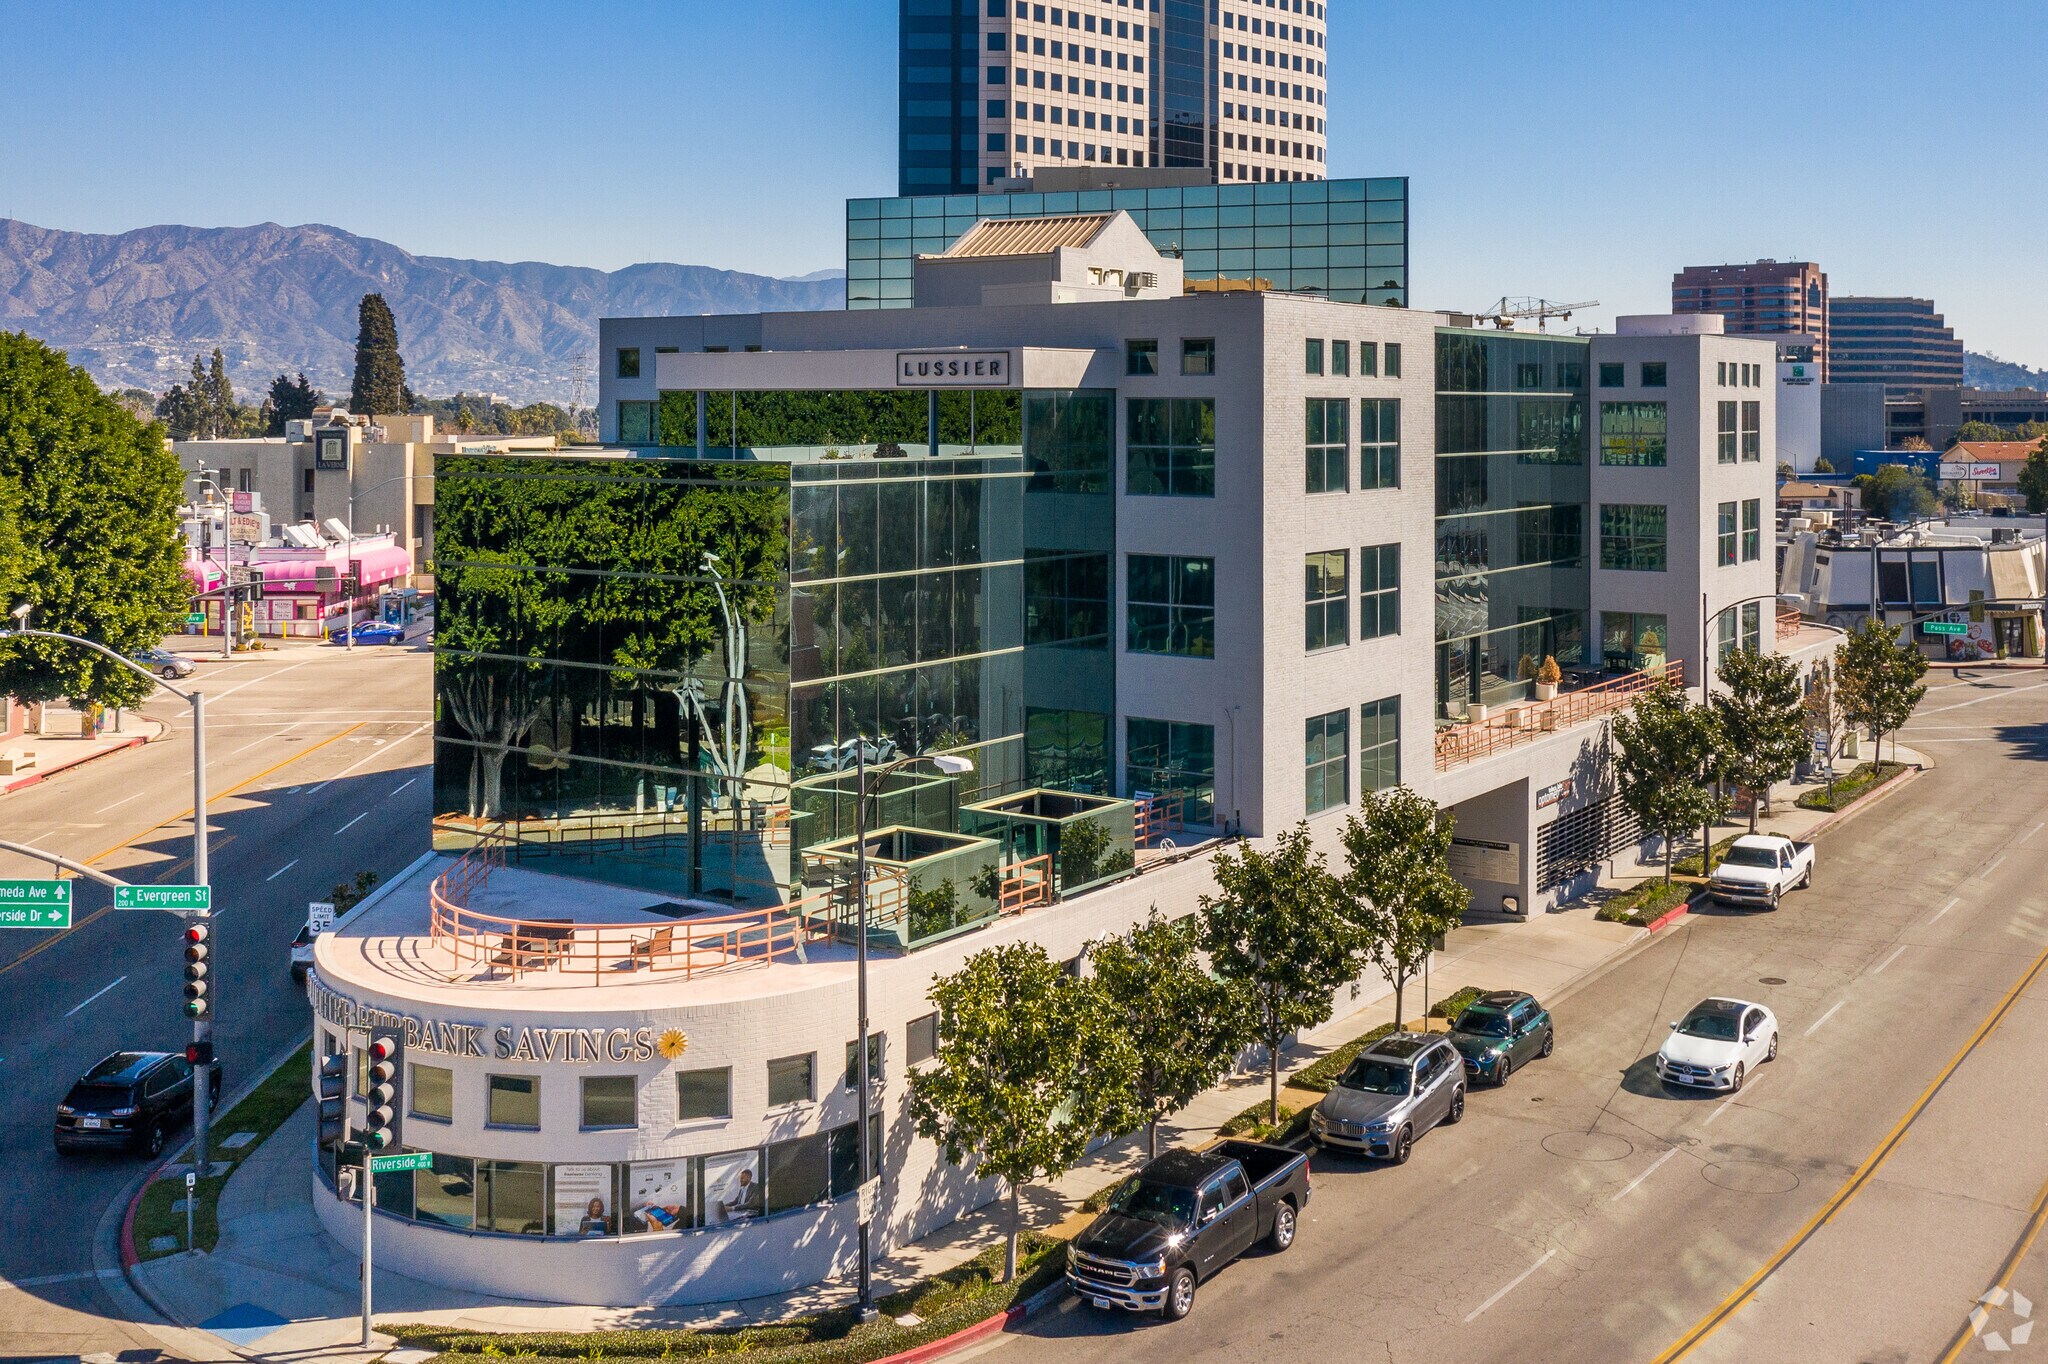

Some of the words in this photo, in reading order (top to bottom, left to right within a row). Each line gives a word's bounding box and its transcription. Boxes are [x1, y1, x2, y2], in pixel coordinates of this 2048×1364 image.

[904, 361, 1000, 376] LUSSIER
[28, 886, 47, 898] Ave
[137, 889, 190, 905] Evergreen
[195, 889, 207, 901] St
[30, 909, 42, 922] Dr
[494, 1026, 654, 1063] SAVINGS
[372, 1158, 416, 1171] Riverside
[1089, 1266, 1113, 1275] RAM
